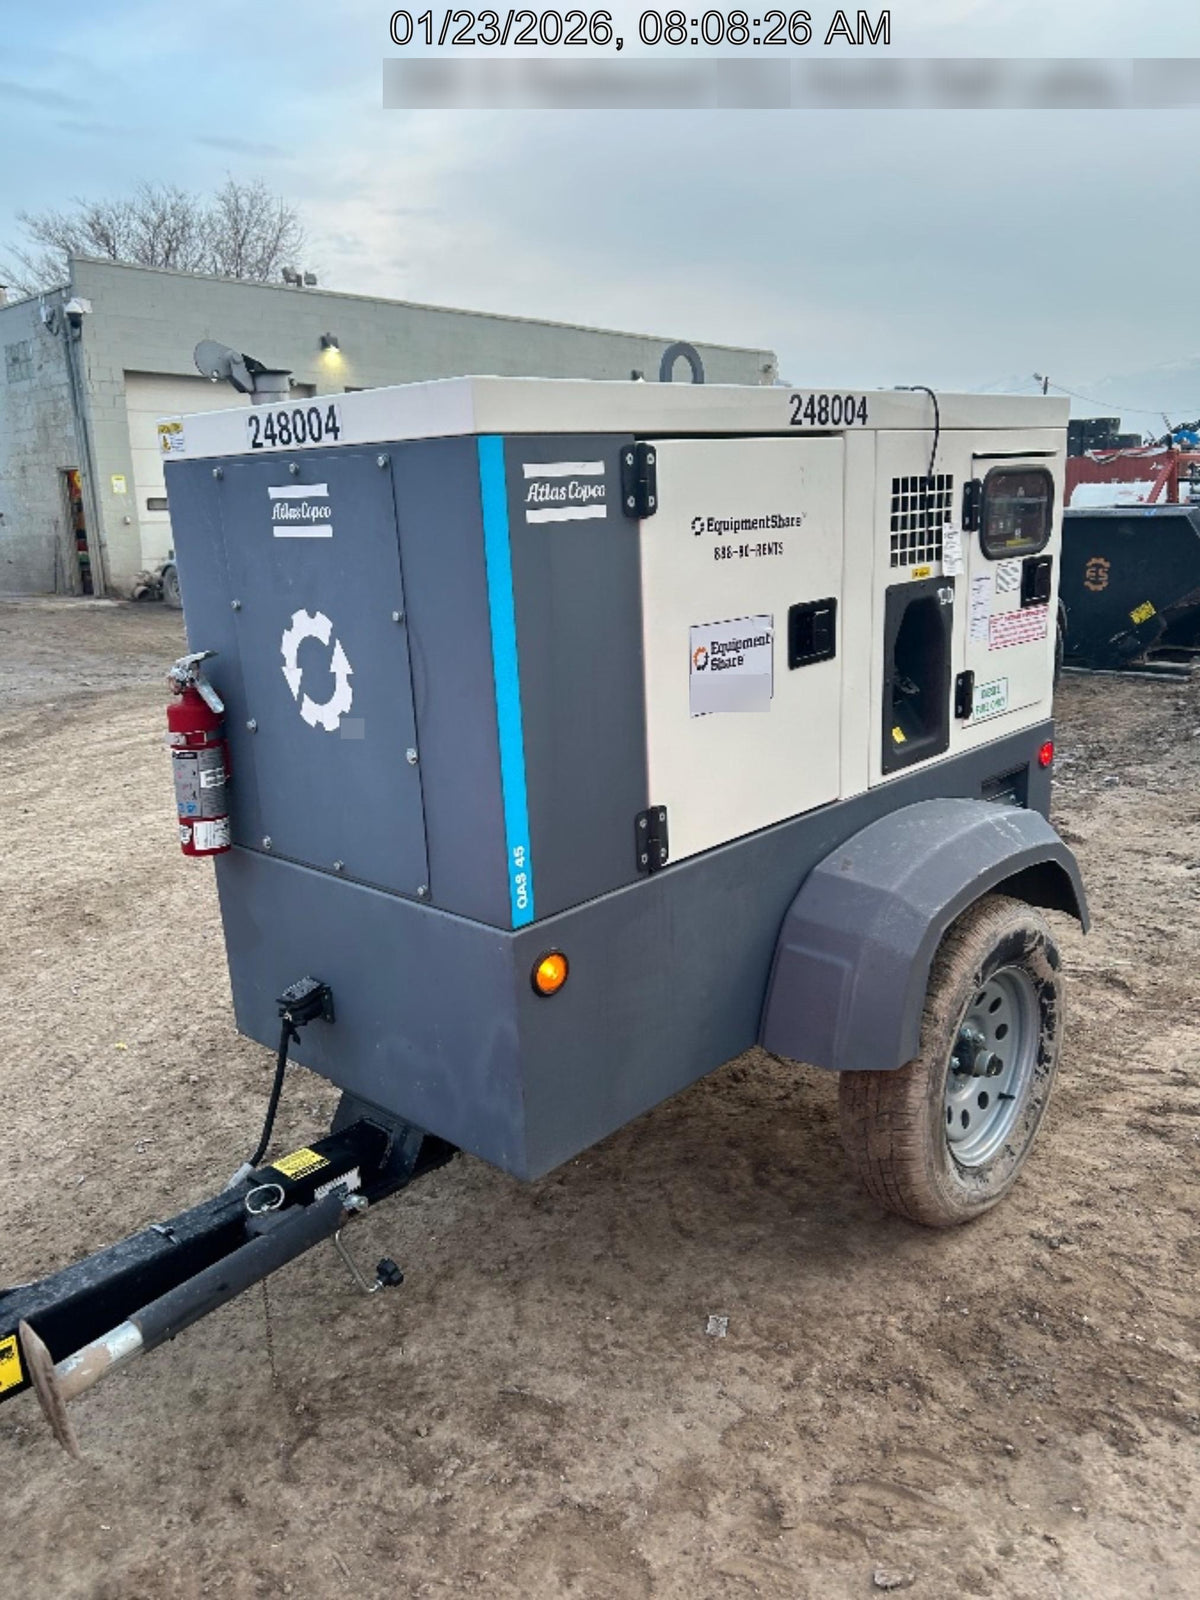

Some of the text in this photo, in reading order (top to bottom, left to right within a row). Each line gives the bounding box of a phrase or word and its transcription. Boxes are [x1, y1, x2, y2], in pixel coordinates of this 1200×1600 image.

[789, 394, 868, 425] 248004
[248, 405, 340, 448] 248004
[525, 481, 605, 502] Atlas Copco
[271, 502, 301, 520] Atlas
[707, 515, 801, 535] EquipmentShare
[710, 633, 770, 656] Equipment
[710, 656, 744, 671] Share
[513, 846, 527, 909] QAS 45
